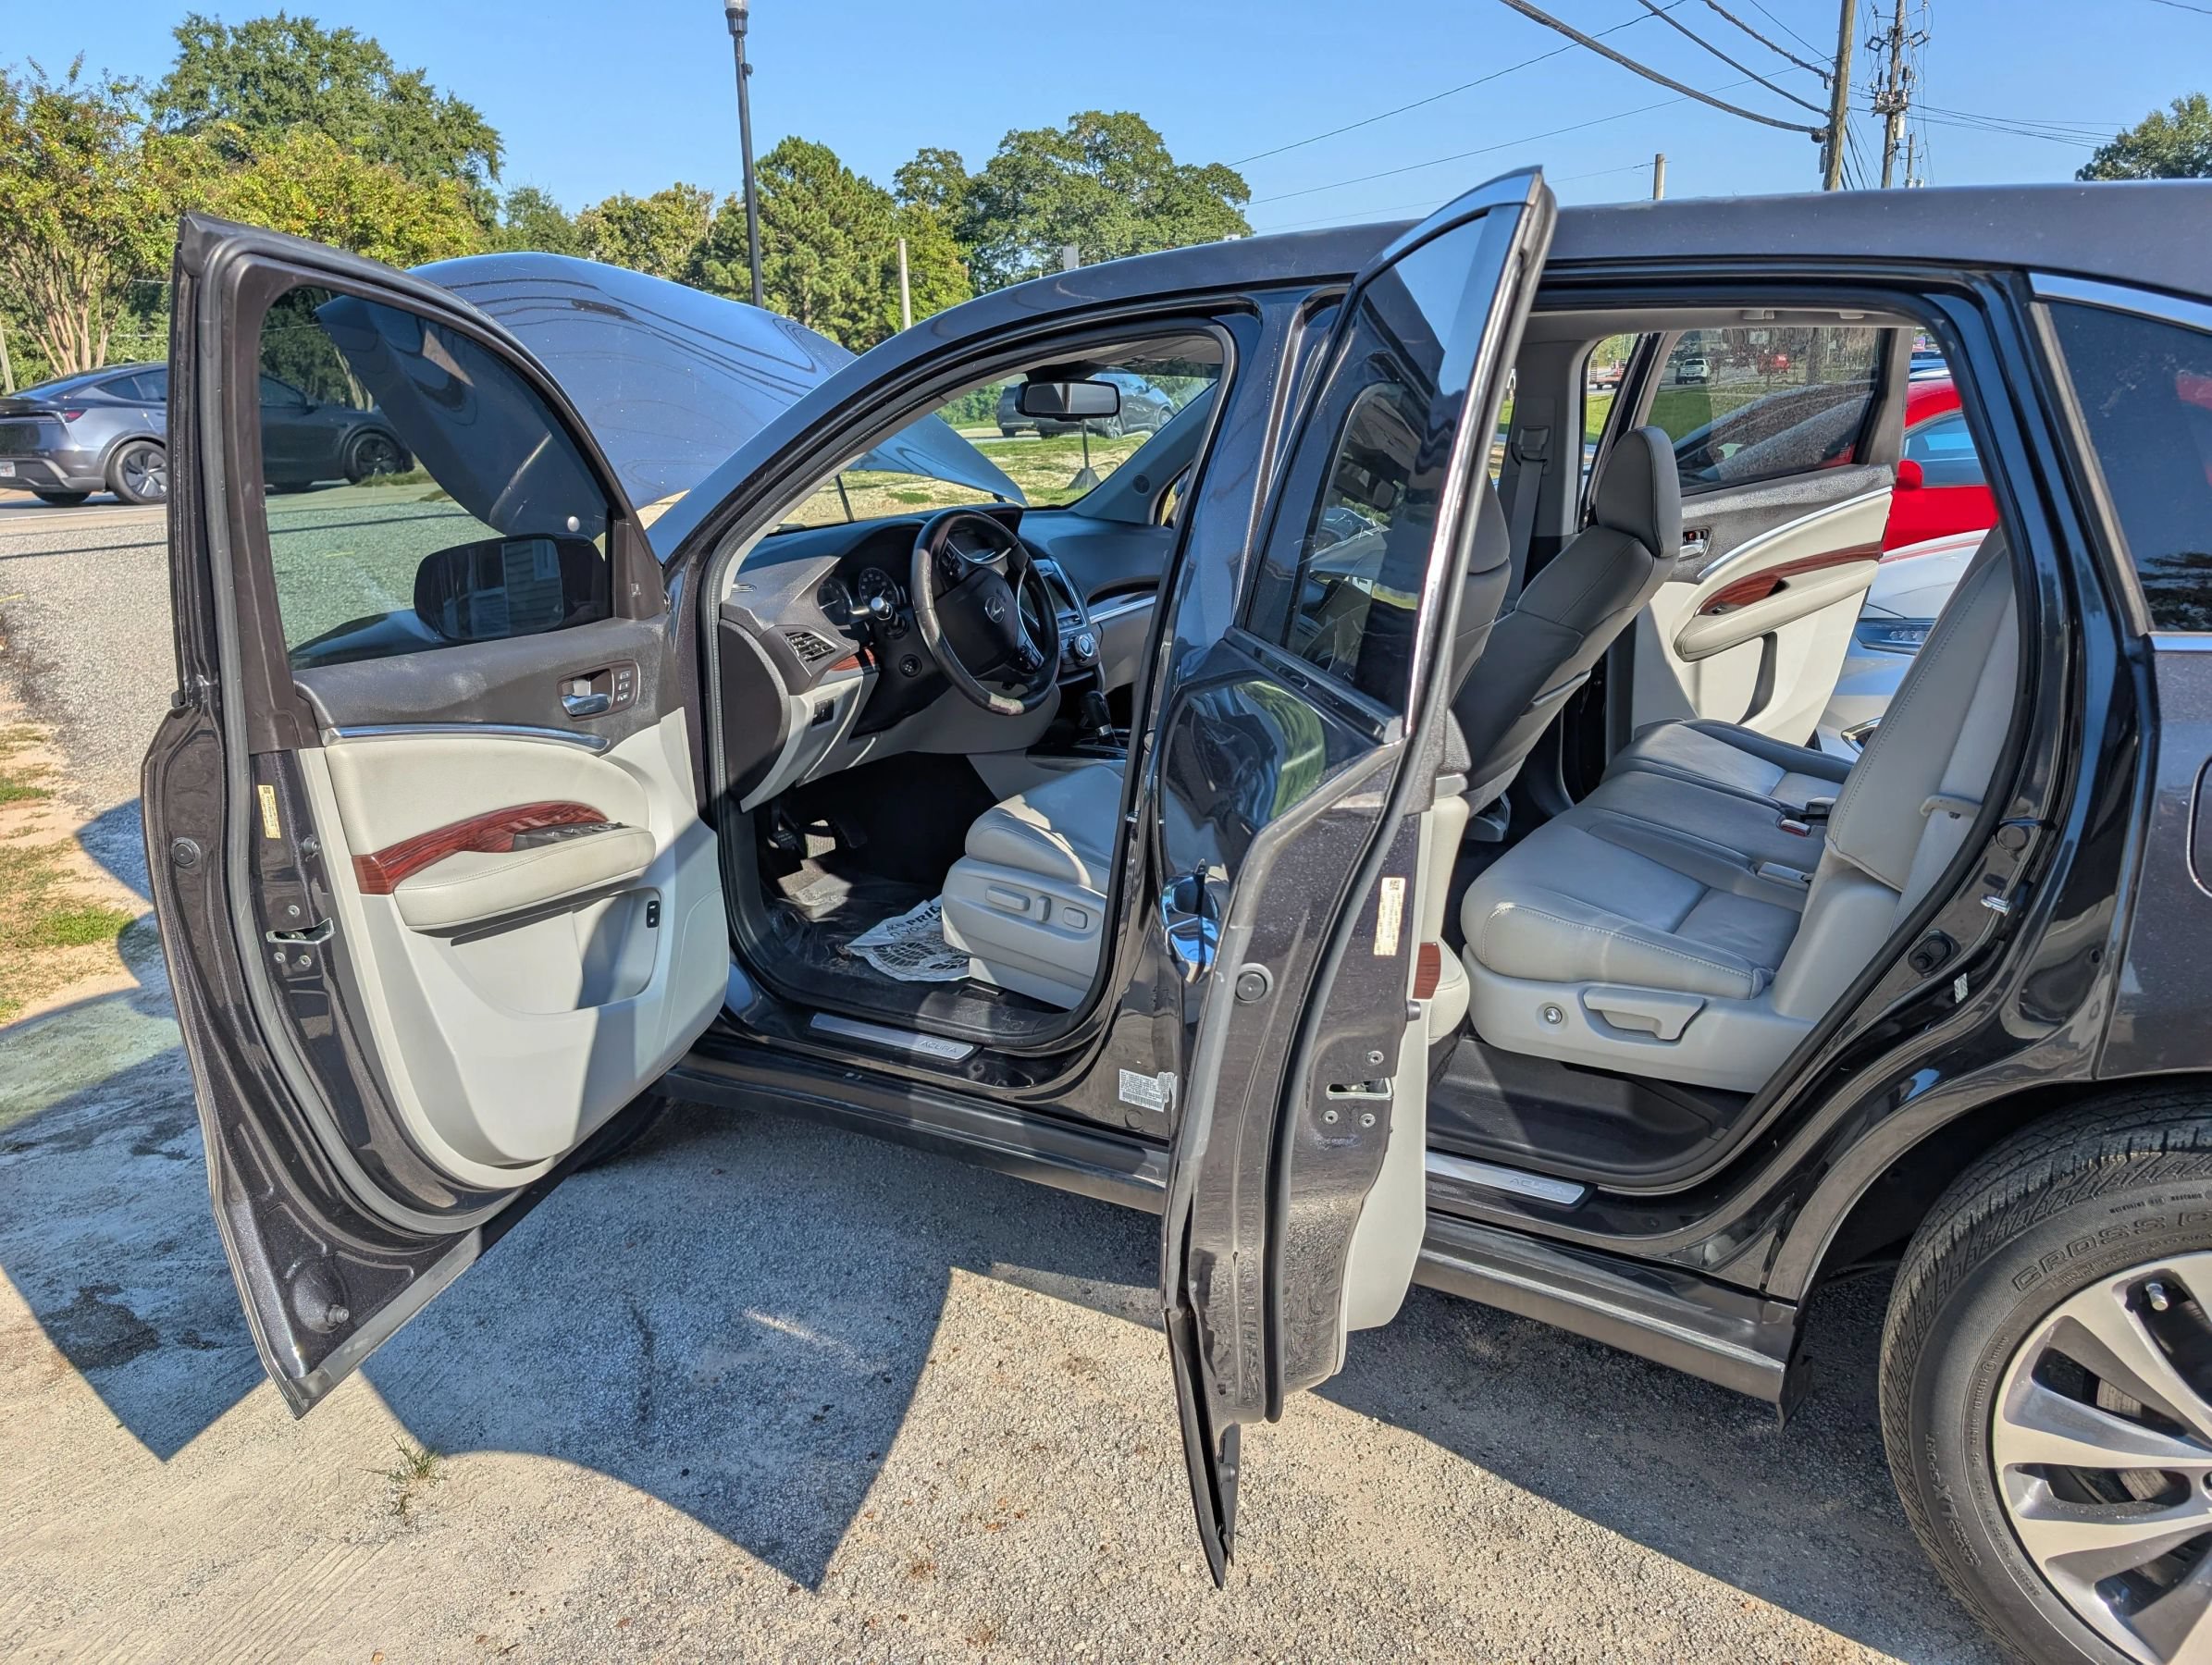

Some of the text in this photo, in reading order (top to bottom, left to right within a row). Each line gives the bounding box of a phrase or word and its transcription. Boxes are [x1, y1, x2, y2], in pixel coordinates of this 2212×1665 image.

[919, 1040, 957, 1054] ACURA
[1509, 1178, 1563, 1195] ACURA
[2011, 1214, 2167, 1292] CROSS
[1925, 1434, 1941, 1483] SPORT
